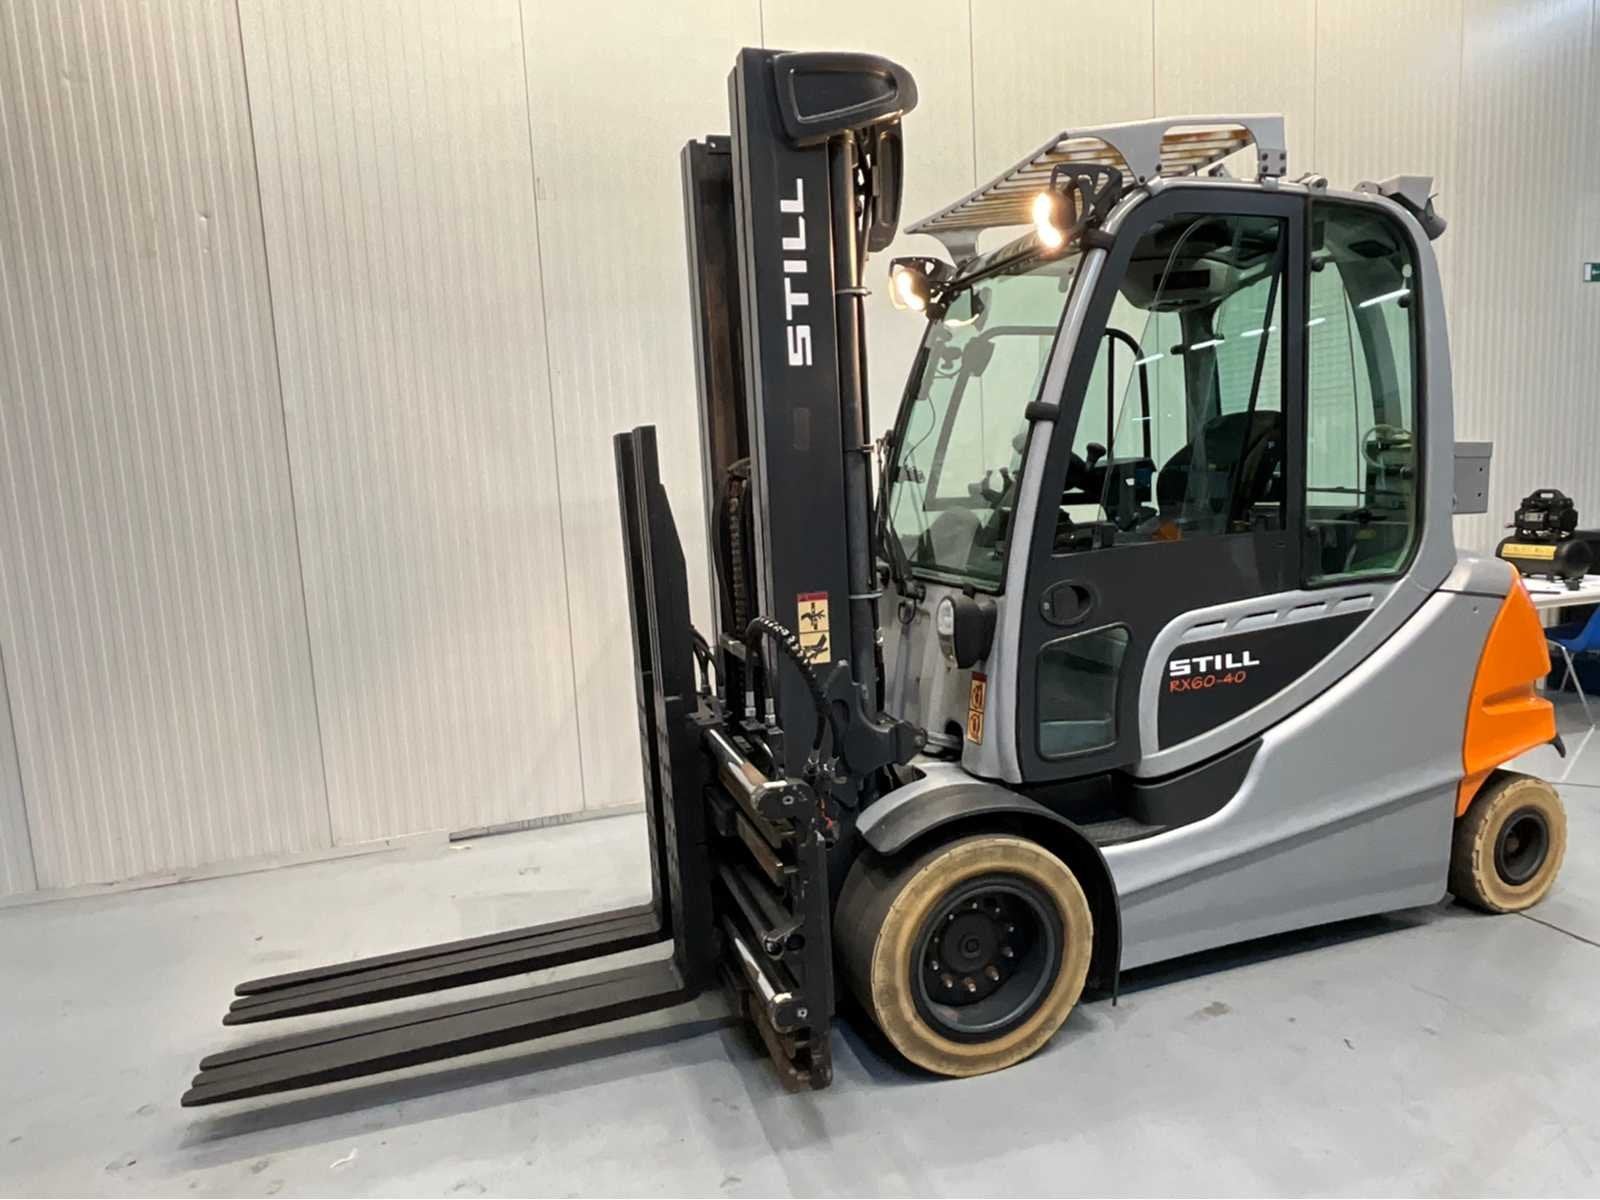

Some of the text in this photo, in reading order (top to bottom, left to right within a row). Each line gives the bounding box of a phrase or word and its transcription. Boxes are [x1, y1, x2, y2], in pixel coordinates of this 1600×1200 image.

[780, 178, 812, 366] STILL
[1169, 650, 1260, 677] STILL
[1169, 670, 1247, 693] RX60-40
